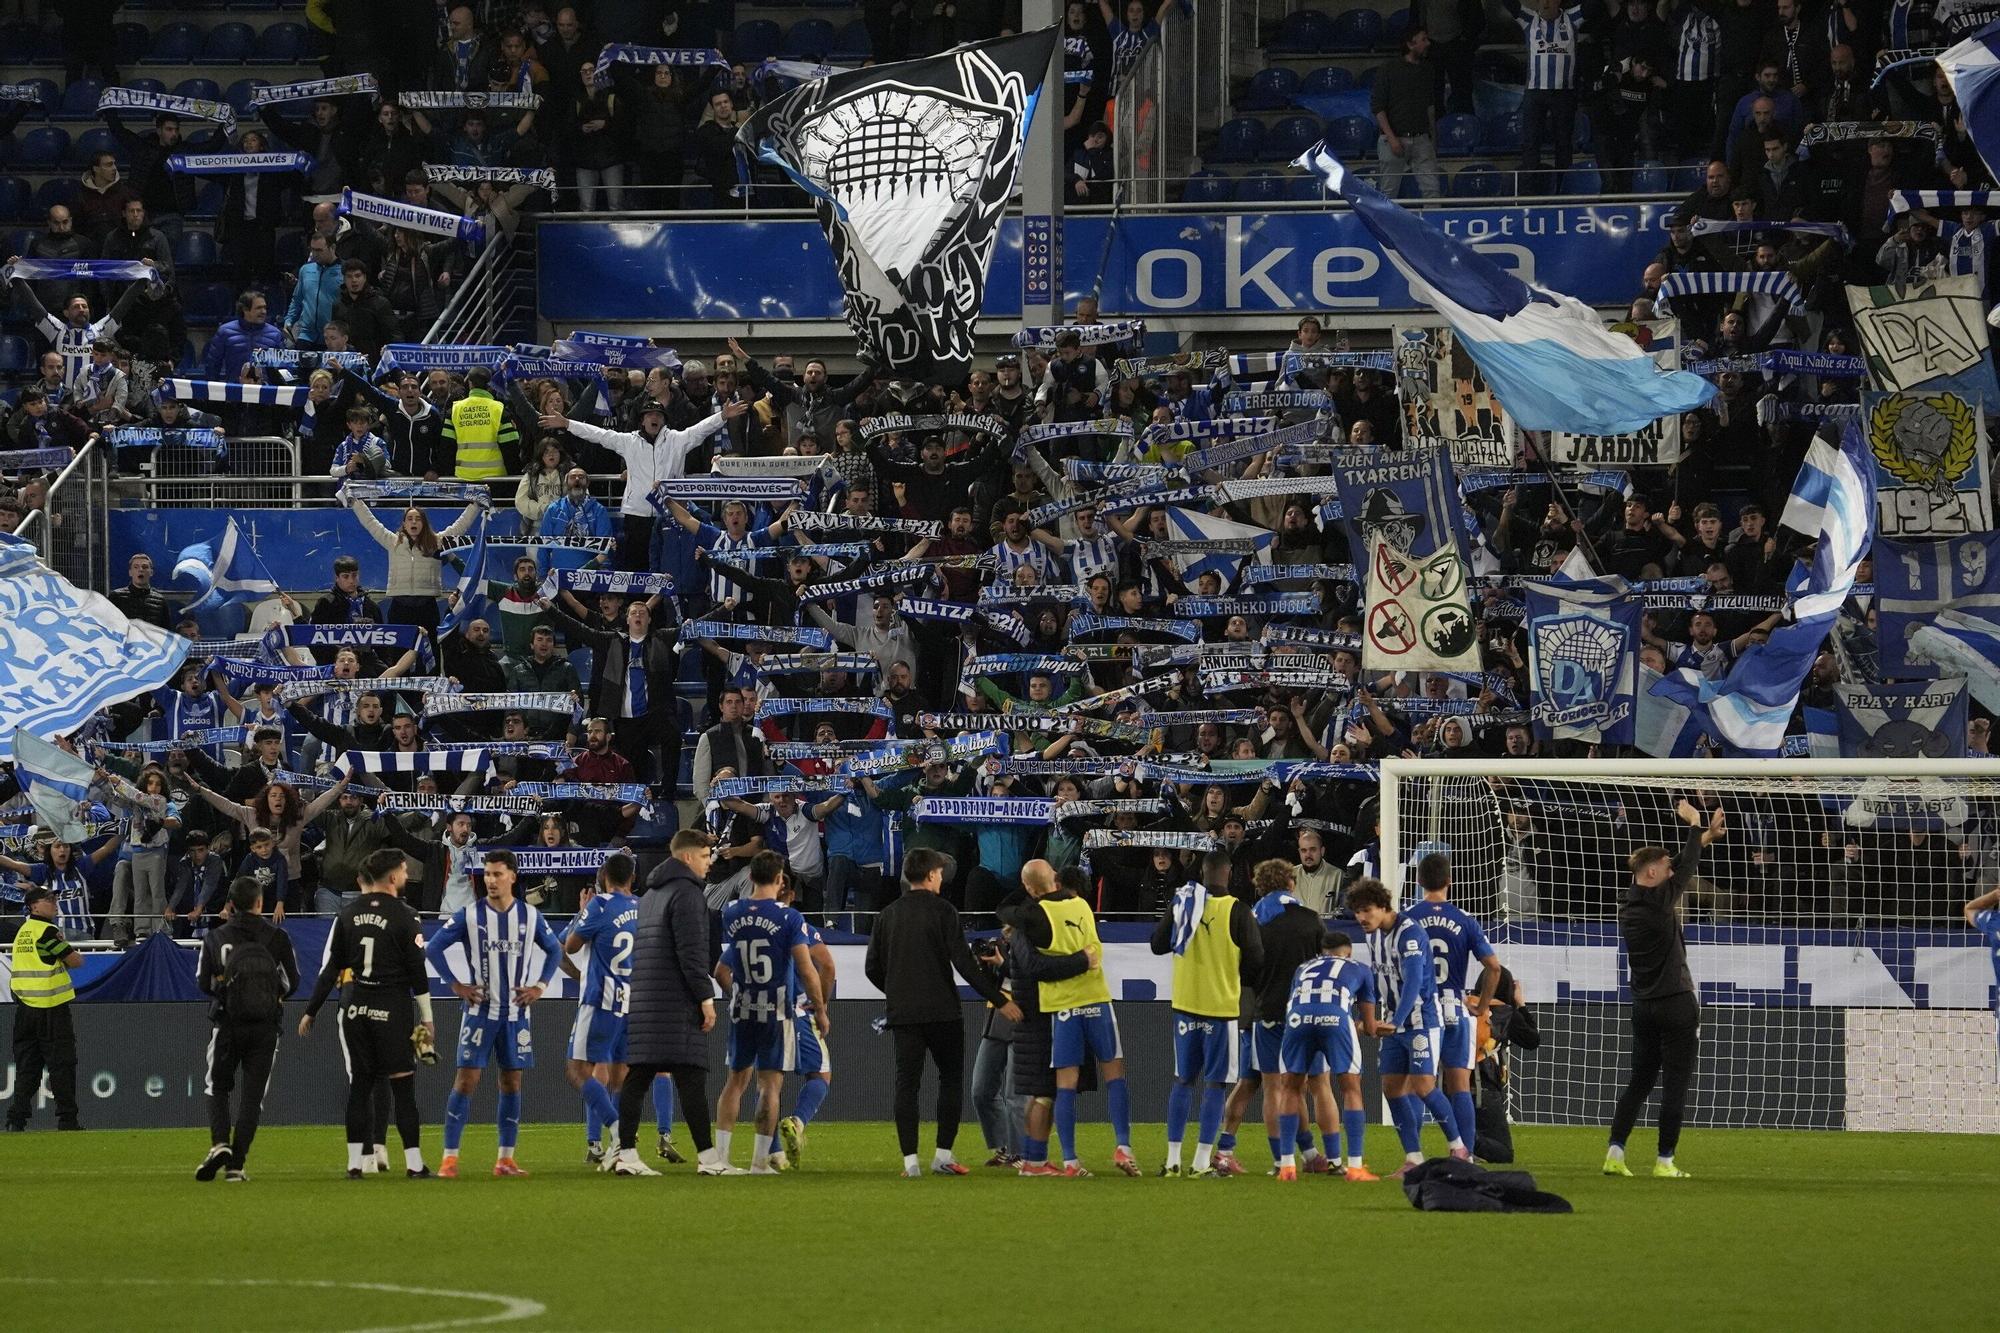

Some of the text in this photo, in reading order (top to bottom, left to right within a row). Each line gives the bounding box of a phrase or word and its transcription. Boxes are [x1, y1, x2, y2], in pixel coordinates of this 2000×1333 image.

[617, 49, 707, 65] ALAVES
[1869, 312, 1975, 372] DA
[1566, 438, 1659, 463] JARDIN
[675, 482, 782, 494] DEPORTIVO ALAVÉS
[1876, 487, 1989, 534] 1921
[310, 629, 398, 645] ALAVÉS
[1848, 692, 1956, 710] PLAY HARD
[940, 713, 1042, 731] KOMANDO
[1547, 703, 1606, 723] GLORIOSO
[849, 753, 903, 775] Expertos
[929, 800, 996, 817] DEPORTIVO
[1002, 799, 1047, 818] ALAVÉS
[560, 849, 605, 868] ALAVÉS
[353, 914, 389, 932] SIVERA
[727, 913, 783, 938] LUCAS BOVÉ
[1421, 917, 1463, 936] UEVARA
[359, 936, 375, 978] 1
[736, 938, 774, 984] 15
[1299, 960, 1346, 980] 21
[1303, 1013, 1312, 1023] El
[462, 1027, 484, 1047] 24
